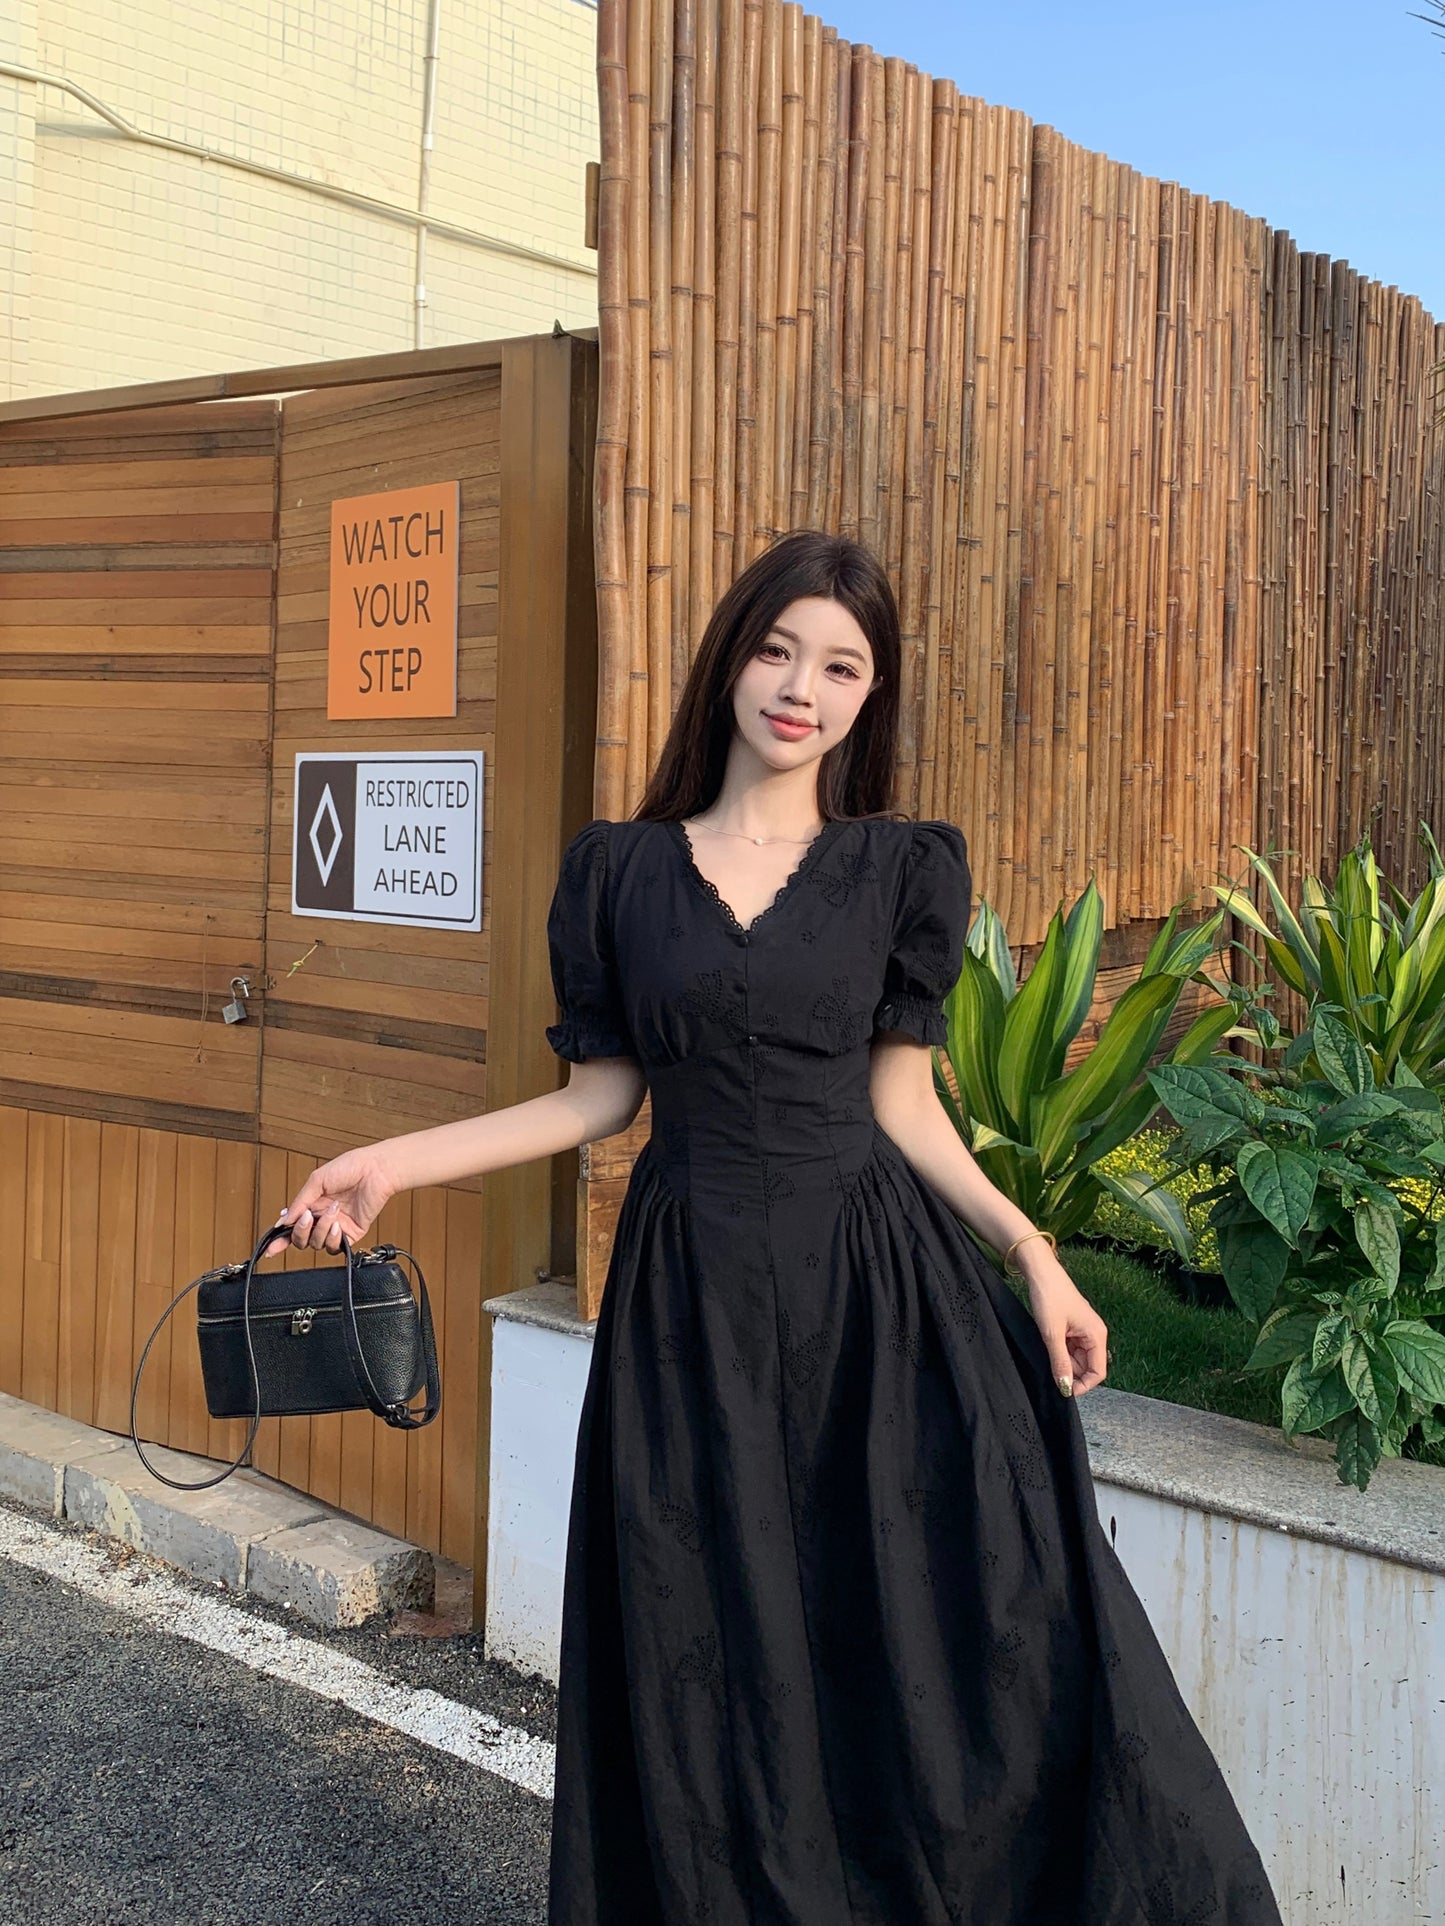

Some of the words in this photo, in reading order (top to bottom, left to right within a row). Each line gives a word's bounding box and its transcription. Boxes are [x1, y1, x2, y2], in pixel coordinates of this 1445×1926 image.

[343, 510, 443, 565] WATCH
[353, 580, 430, 628] YOUR
[359, 648, 421, 693] STEP
[366, 780, 469, 808] RESTRICTED
[385, 825, 446, 854] LANE
[374, 868, 457, 896] AHEAD
